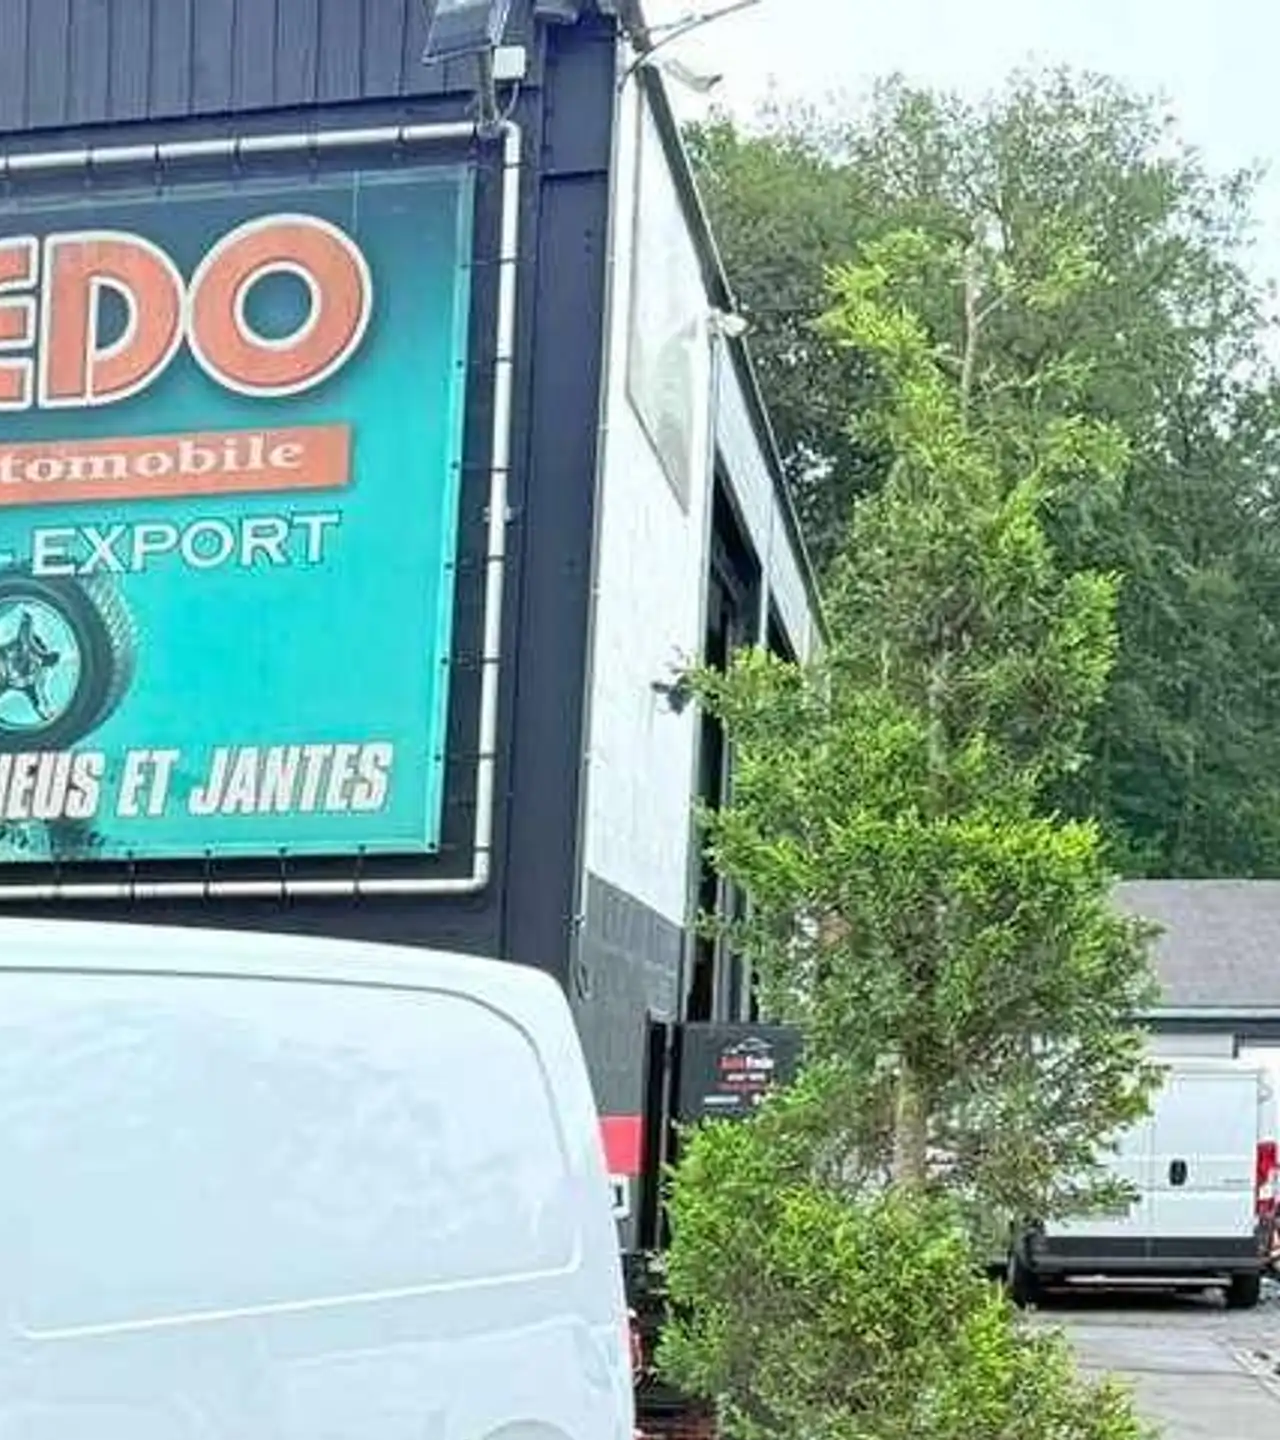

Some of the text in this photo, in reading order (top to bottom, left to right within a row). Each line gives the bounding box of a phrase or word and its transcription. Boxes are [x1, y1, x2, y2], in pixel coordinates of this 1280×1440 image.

[31, 511, 342, 577] EXPORT
[117, 748, 180, 816] ET
[188, 741, 395, 815] JANTES
